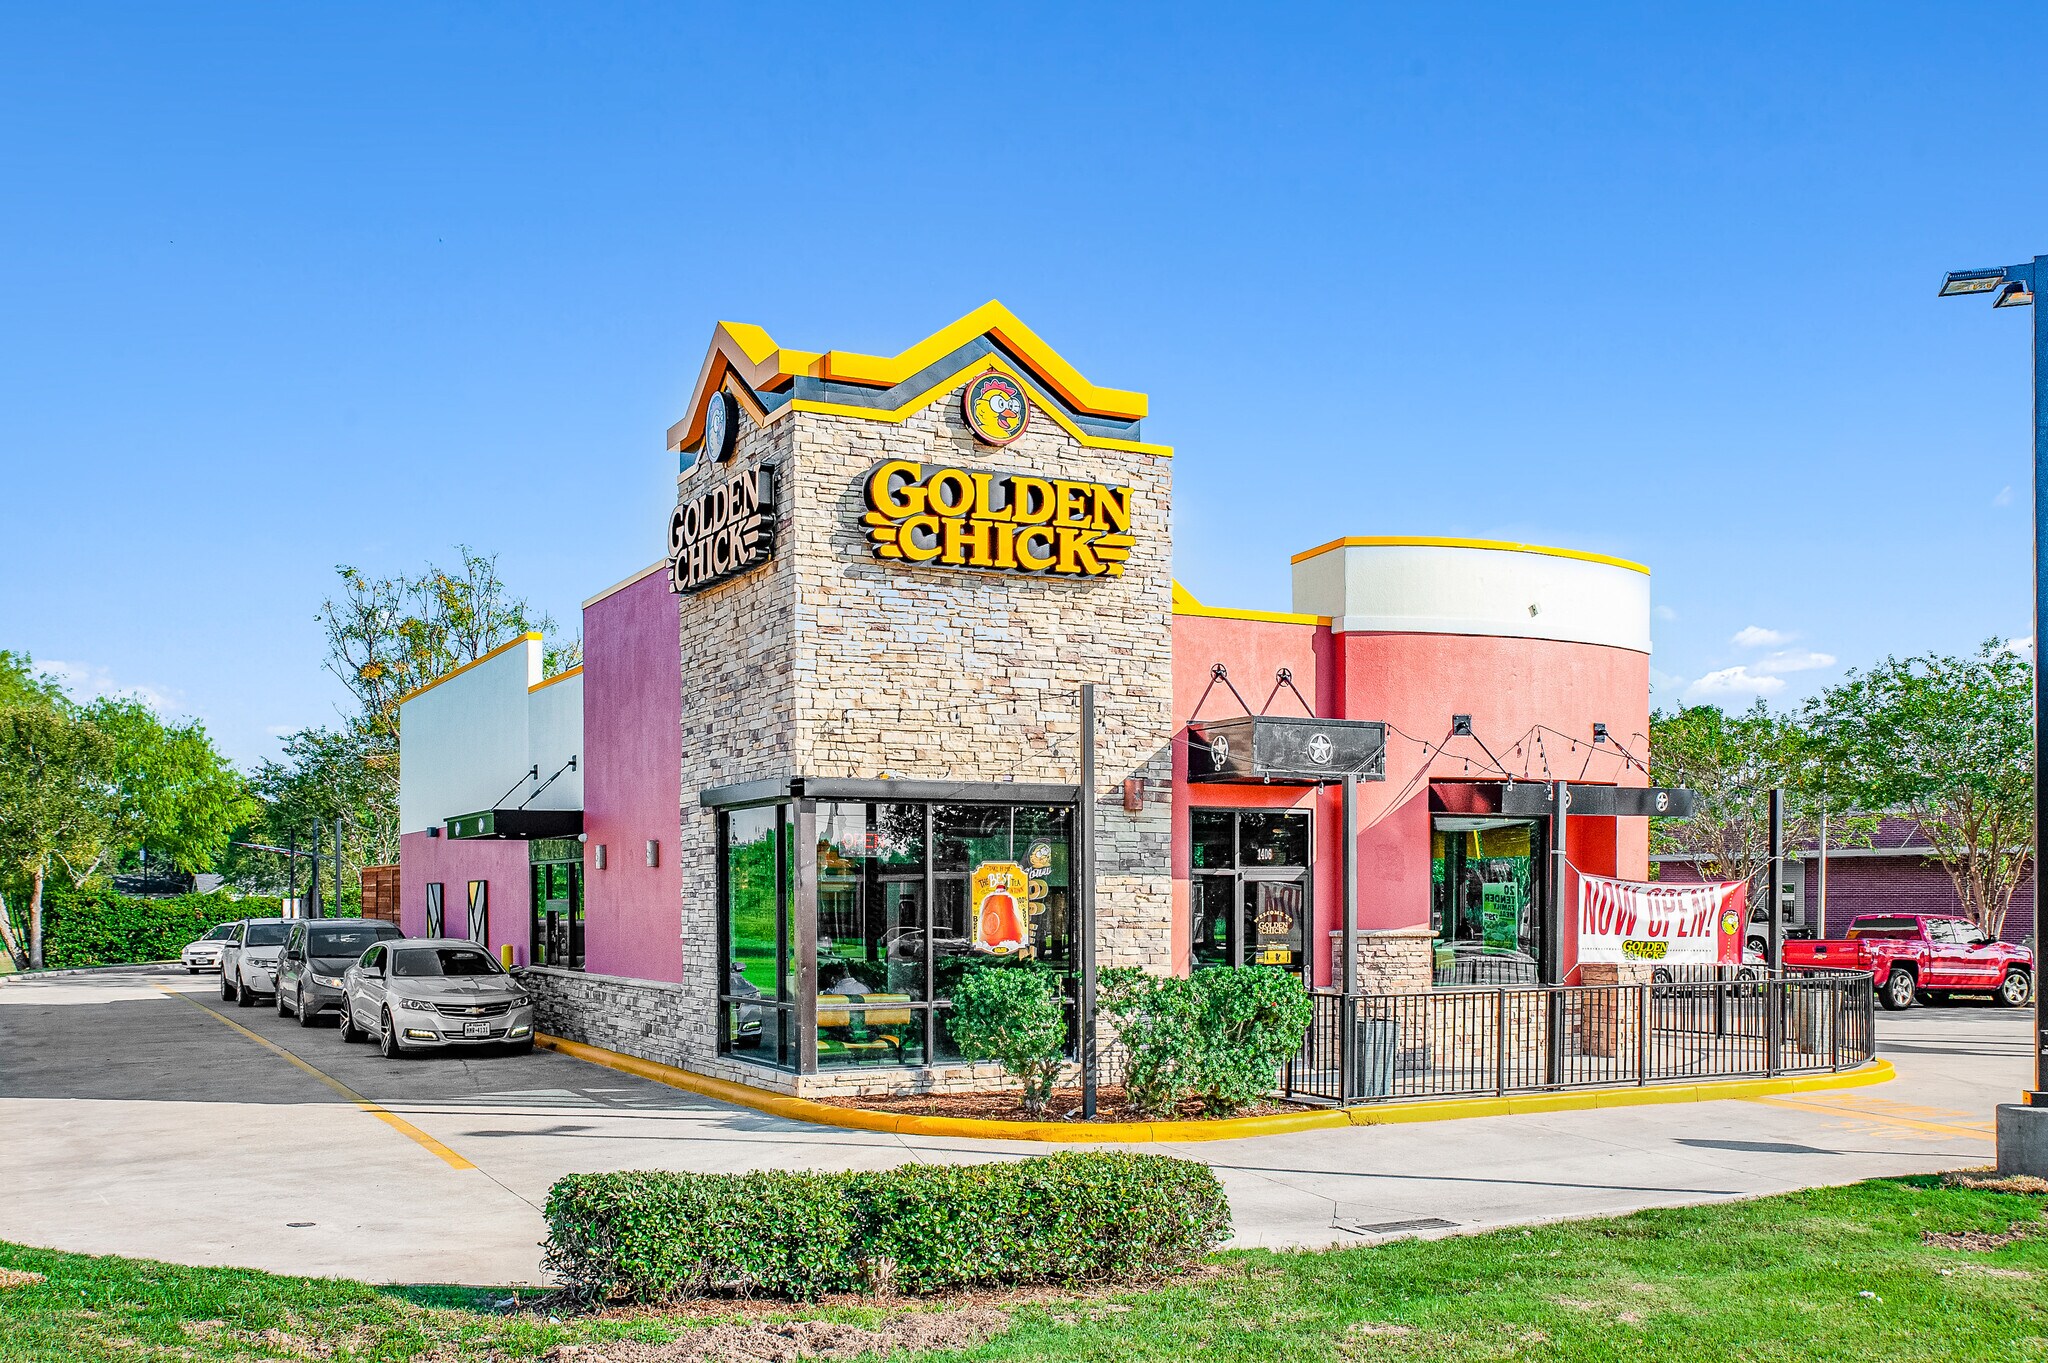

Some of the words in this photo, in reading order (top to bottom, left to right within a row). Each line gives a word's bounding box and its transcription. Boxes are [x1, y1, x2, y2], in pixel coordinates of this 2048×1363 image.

[668, 463, 761, 557] GOLDEN
[869, 460, 1135, 532] GOLDEN
[675, 518, 749, 591] CHICK
[898, 515, 1107, 576] CHICK
[988, 872, 1013, 888] BEST
[1011, 878, 1021, 887] TEA
[1254, 910, 1284, 923] WELCOME
[1285, 915, 1293, 923] TO
[1258, 921, 1289, 929] GOLDEN
[1583, 881, 1640, 936] NOW
[1646, 887, 1716, 938] OPEN!
[1622, 940, 1669, 952] GOLDEN
